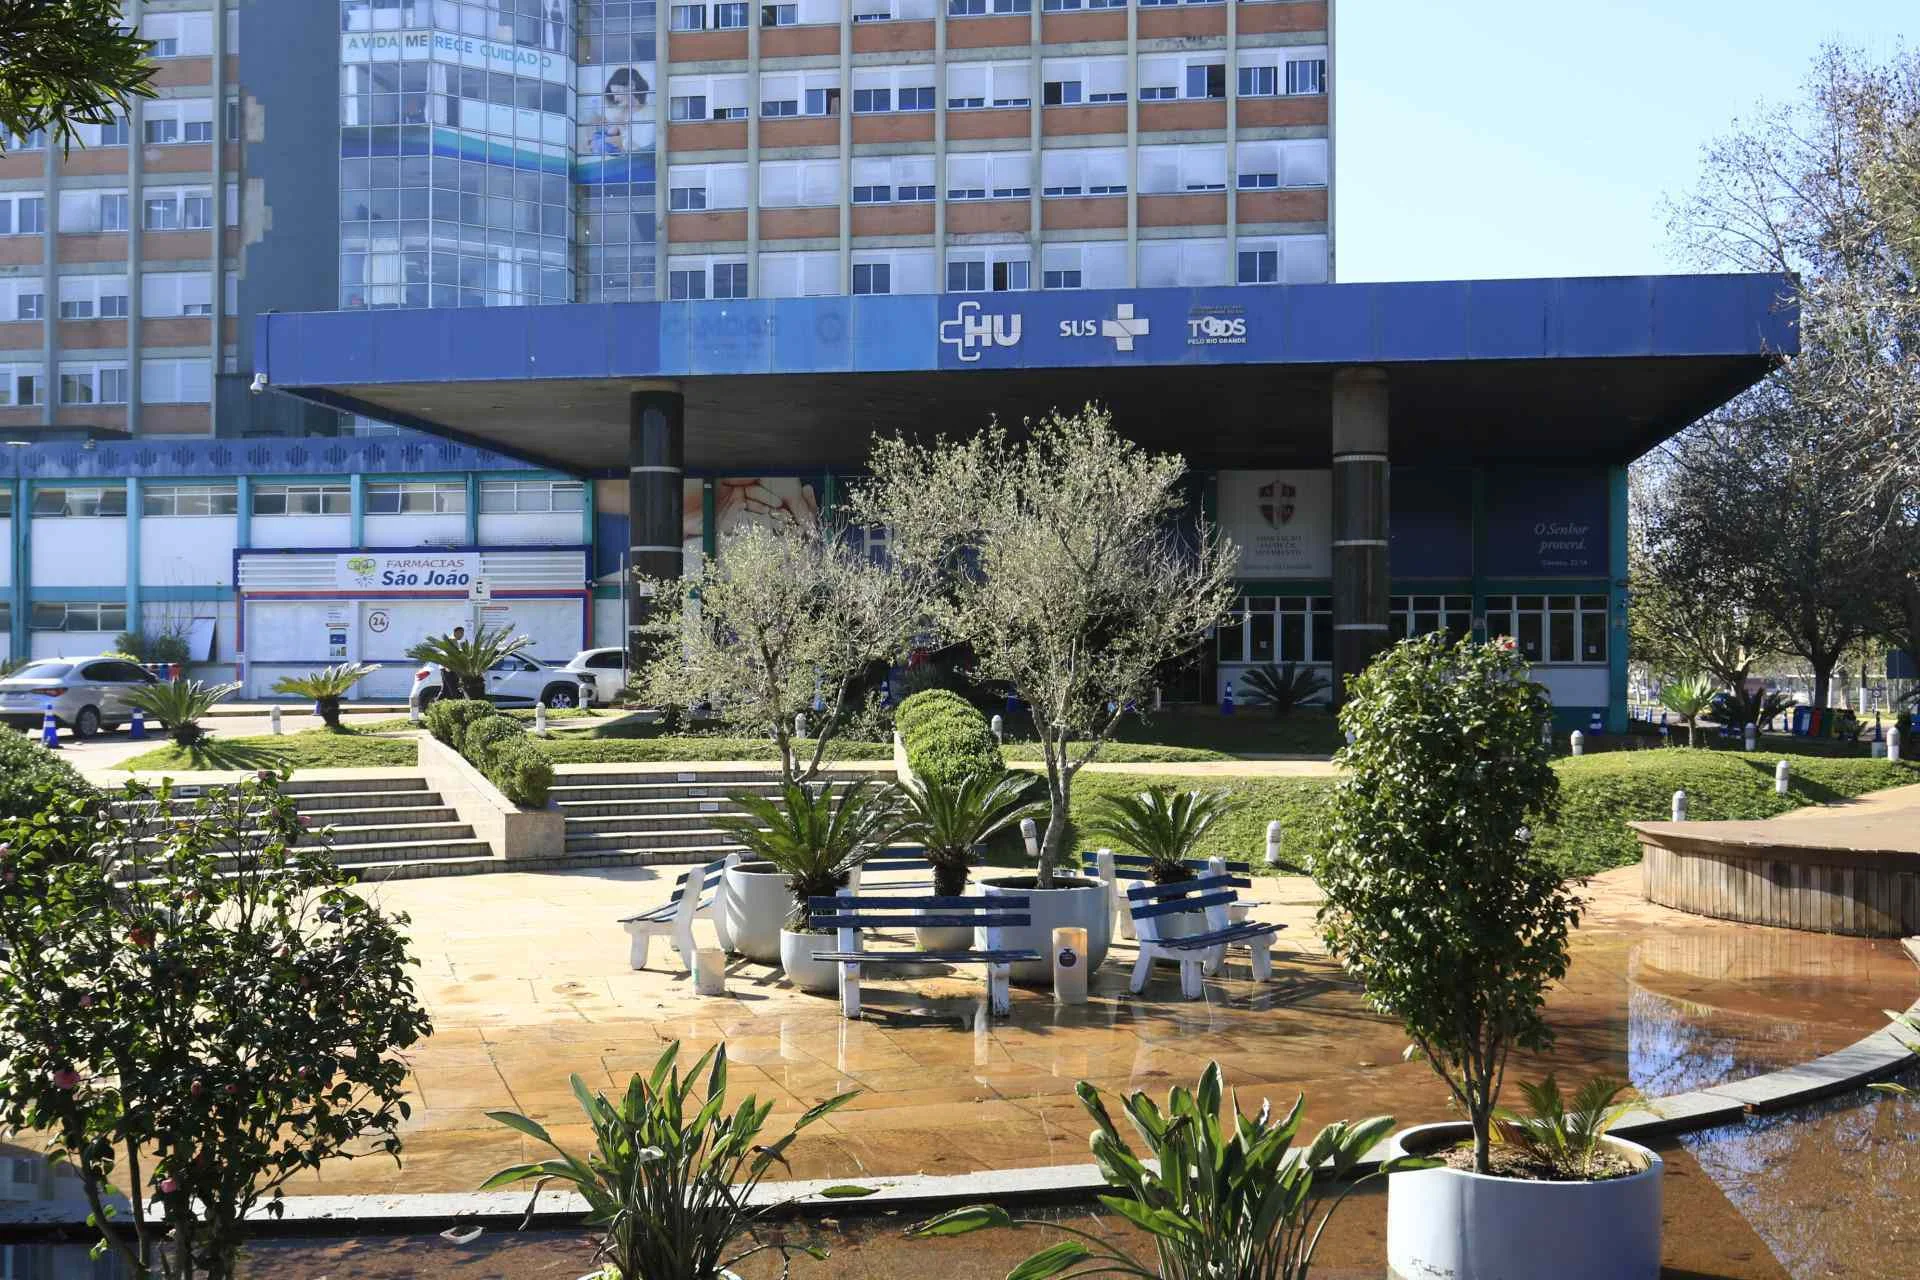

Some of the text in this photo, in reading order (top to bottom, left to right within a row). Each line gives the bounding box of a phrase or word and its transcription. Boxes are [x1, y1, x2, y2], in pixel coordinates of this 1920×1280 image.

[348, 37, 360, 49] A
[361, 35, 398, 48] VIDA
[964, 313, 1022, 347] HU
[1059, 319, 1097, 337] SUS
[382, 569, 470, 586] São João
[372, 616, 386, 627] 24
